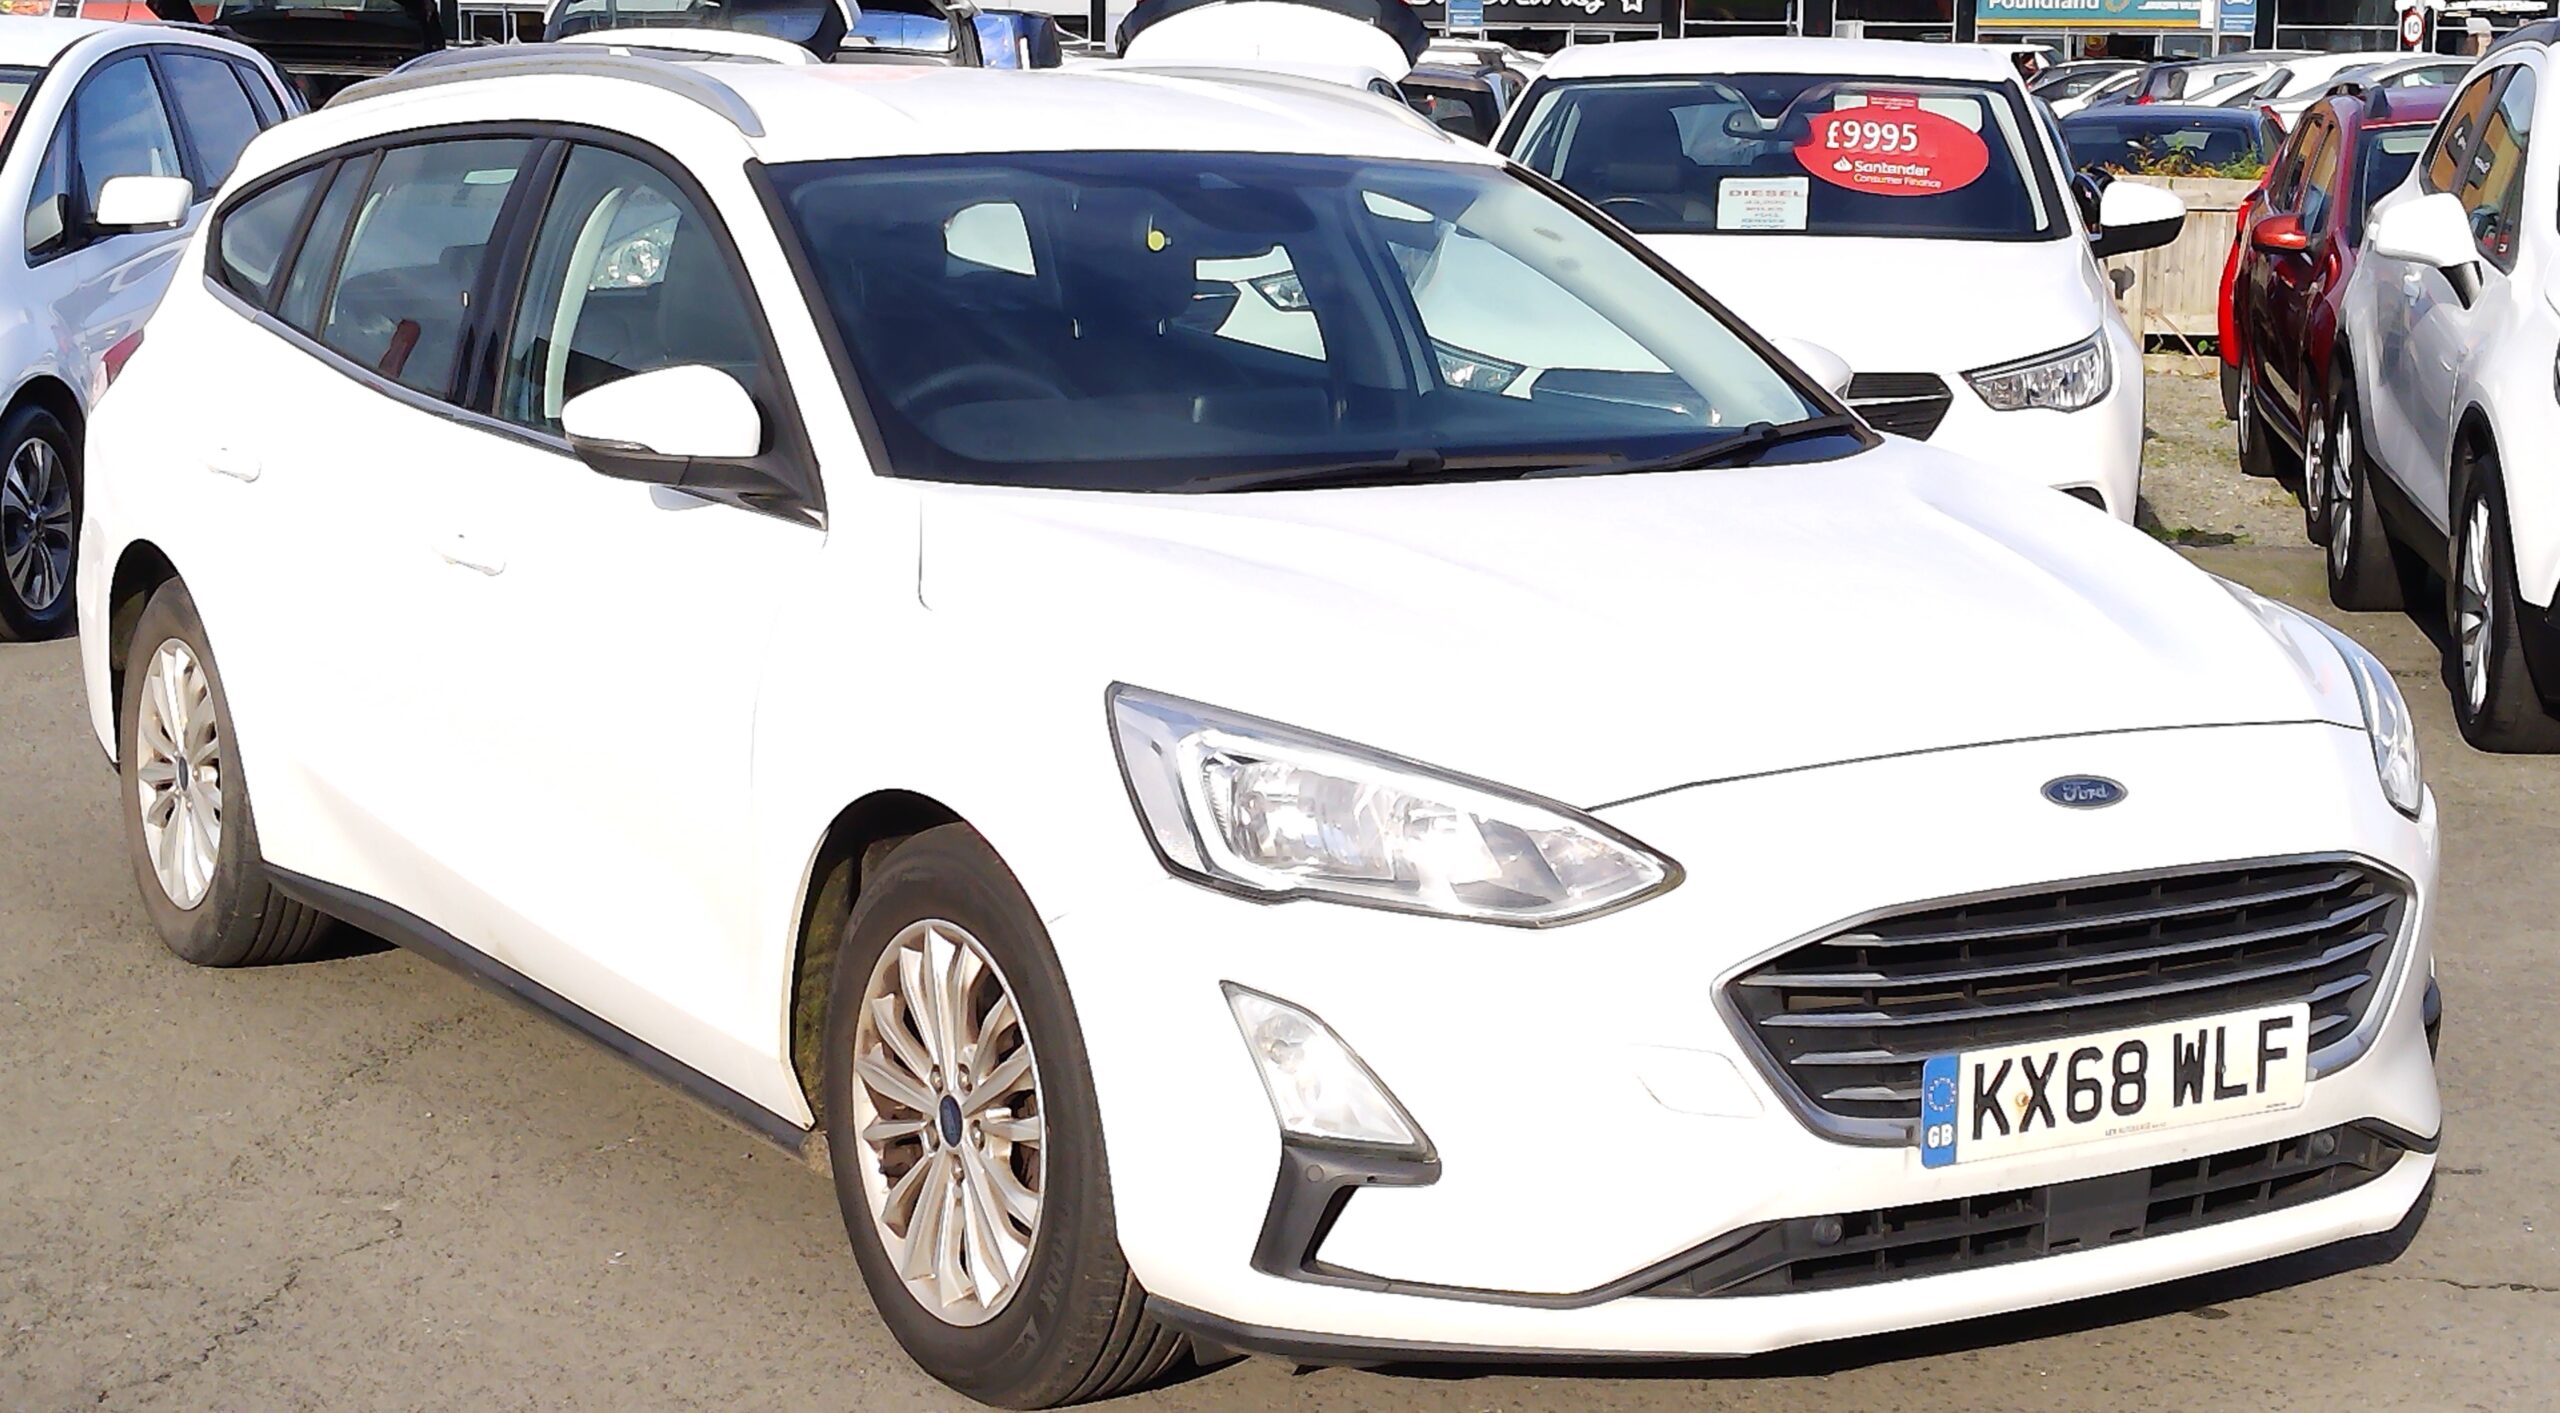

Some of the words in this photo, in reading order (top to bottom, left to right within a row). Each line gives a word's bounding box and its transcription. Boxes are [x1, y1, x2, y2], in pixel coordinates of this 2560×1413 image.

[2407, 21, 2420, 36] 10
[1826, 120, 1918, 152] £9995
[1854, 160, 1931, 177] Santander
[1853, 174, 1903, 185] Consumer
[1904, 176, 1942, 189] Finance
[1728, 189, 1805, 198] DIESEL
[2062, 780, 2109, 802] Ford
[1972, 1039, 2149, 1140] KX68
[2173, 1015, 2293, 1109] WLF
[1927, 1123, 1953, 1149] GB
